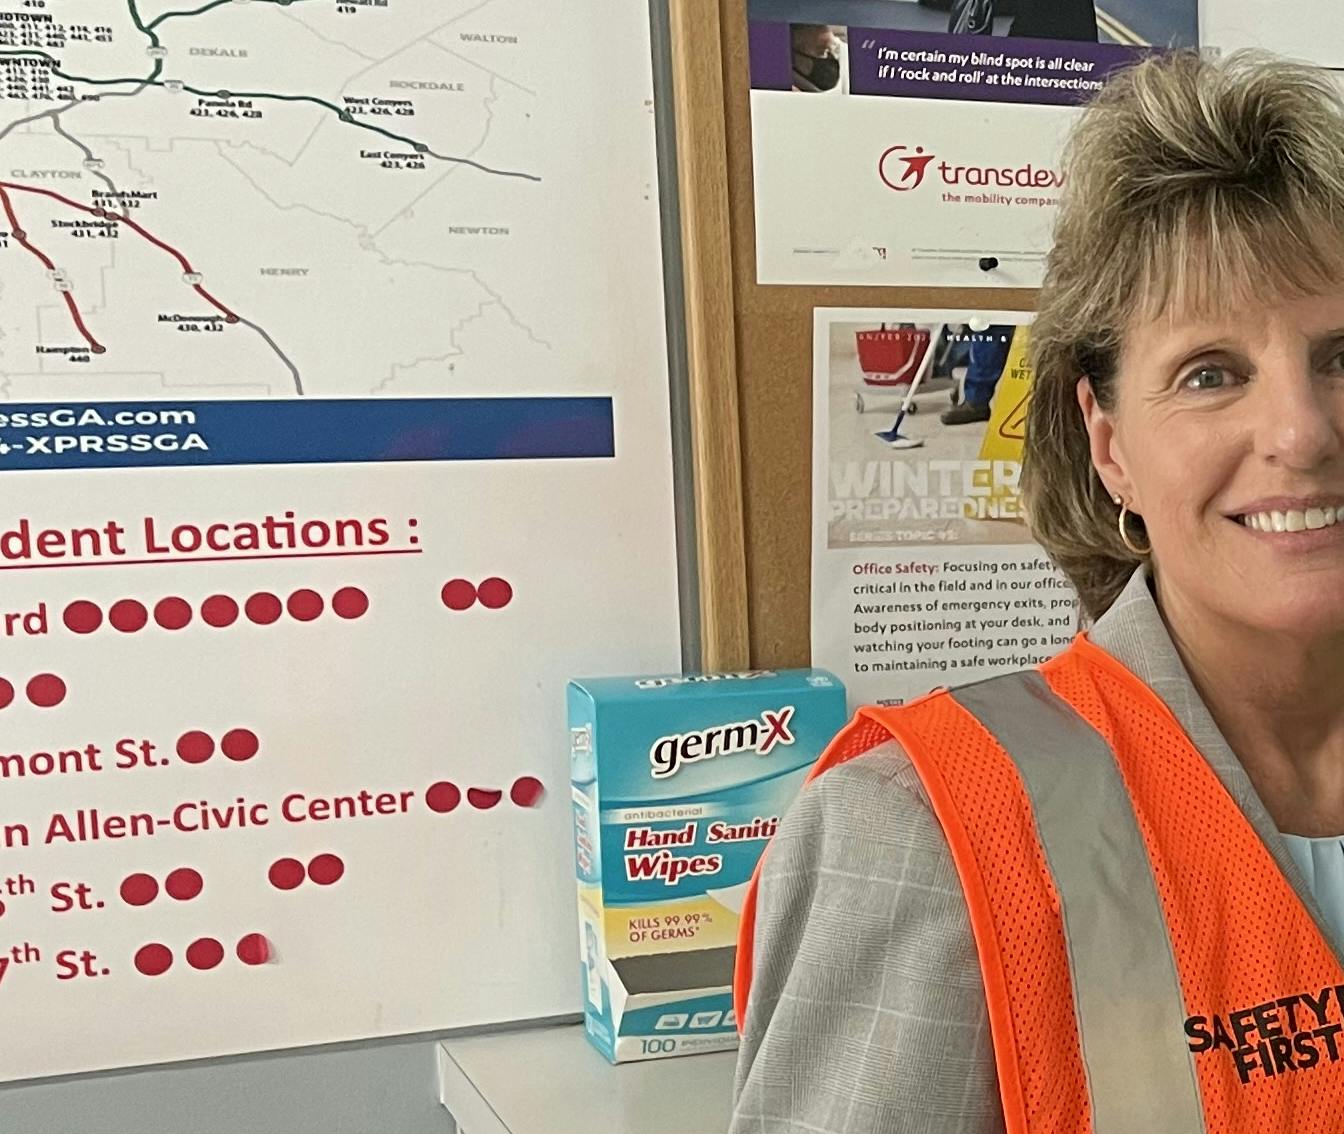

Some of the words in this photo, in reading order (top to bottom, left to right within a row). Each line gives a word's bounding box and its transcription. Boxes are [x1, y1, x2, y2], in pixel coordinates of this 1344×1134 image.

[459, 33, 518, 43] WALTON
[901, 50, 946, 63] certain
[948, 54, 969, 66] my
[970, 53, 1004, 66] blind
[1005, 56, 1034, 71] spot
[1035, 56, 1046, 69] is
[1047, 57, 1063, 70] all
[1064, 58, 1095, 72] clear
[878, 65, 890, 78] if
[932, 69, 957, 82] and
[986, 73, 999, 85] at
[1001, 73, 1023, 87] the
[389, 80, 464, 91] ROCKDALE
[11, 169, 82, 179] CLAYTON
[937, 161, 1067, 188] transdev
[942, 193, 961, 203] the
[964, 193, 1013, 206] mobility
[448, 226, 510, 236] NEWTON
[259, 267, 310, 276] HENRY
[946, 334, 993, 343] HEALTH
[830, 460, 1023, 497] WINTER
[0, 519, 126, 560] dent
[143, 512, 391, 555] Locations
[852, 563, 892, 575] Office
[895, 562, 939, 576] Safety:
[943, 561, 998, 574] Focusing
[1001, 563, 1017, 571] on
[853, 582, 896, 595] critical
[899, 582, 912, 593] in
[914, 582, 935, 593] the
[938, 580, 967, 592] field
[969, 580, 993, 591] and
[996, 578, 1007, 590] in
[1010, 581, 1032, 590] our
[853, 602, 923, 614] Awareness
[925, 600, 938, 611] of
[941, 601, 1011, 613] emergency
[1014, 598, 1047, 610] exits,
[1050, 599, 1079, 610] prop
[4, 603, 48, 636] rd
[854, 622, 887, 635] body
[890, 619, 962, 634] positioning
[964, 619, 977, 630] at
[979, 619, 1009, 631] your
[1047, 615, 1071, 627] and
[853, 640, 914, 654] watching
[916, 641, 945, 652] your
[948, 637, 994, 650] footing
[996, 636, 1018, 647] can
[1021, 637, 1037, 648] go
[1040, 637, 1047, 645] a
[854, 662, 869, 673] to
[872, 658, 947, 672] maintaining
[950, 659, 958, 668] a
[960, 655, 985, 667] safe
[652, 708, 793, 776] germ-X
[0, 743, 102, 778] mont
[115, 739, 170, 770] St.
[4, 823, 30, 848] n
[44, 801, 269, 845] Allen-Civic
[281, 790, 415, 824] Center
[624, 807, 703, 821] antibacterial
[626, 824, 696, 848] Hand
[708, 817, 778, 842] Saniti
[627, 851, 721, 883] Wipes
[50, 882, 105, 912] St.
[629, 917, 660, 930] KILLS
[629, 931, 647, 943] OF
[56, 949, 110, 980] St.
[641, 1038, 676, 1054] 100
